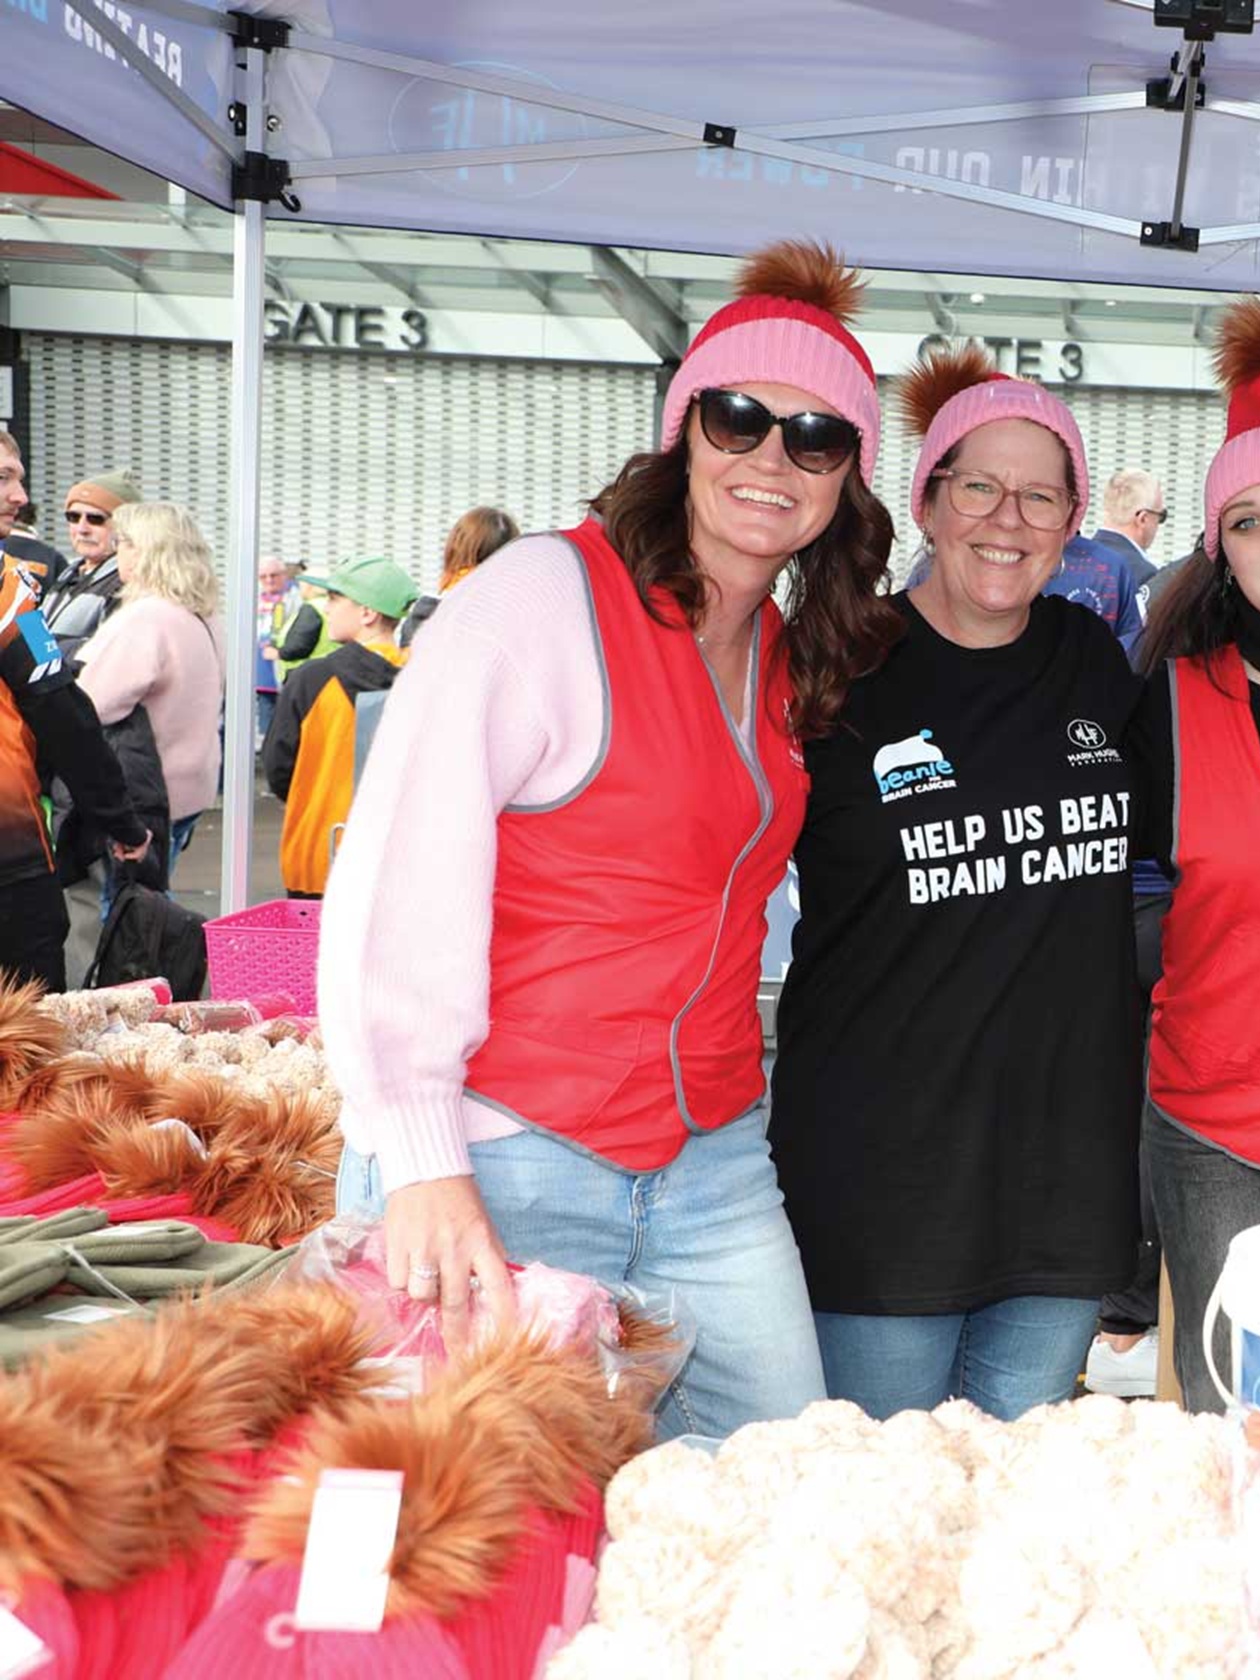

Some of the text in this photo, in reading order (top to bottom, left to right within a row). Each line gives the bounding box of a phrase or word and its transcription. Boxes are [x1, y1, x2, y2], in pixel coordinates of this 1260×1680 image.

[264, 301, 428, 350] GATE 3
[1059, 342, 1083, 382] 3
[882, 780, 957, 804] BRAIN CANCER
[900, 792, 1130, 861] HELP US BEAT
[908, 837, 1128, 904] BRAIN CANCER
